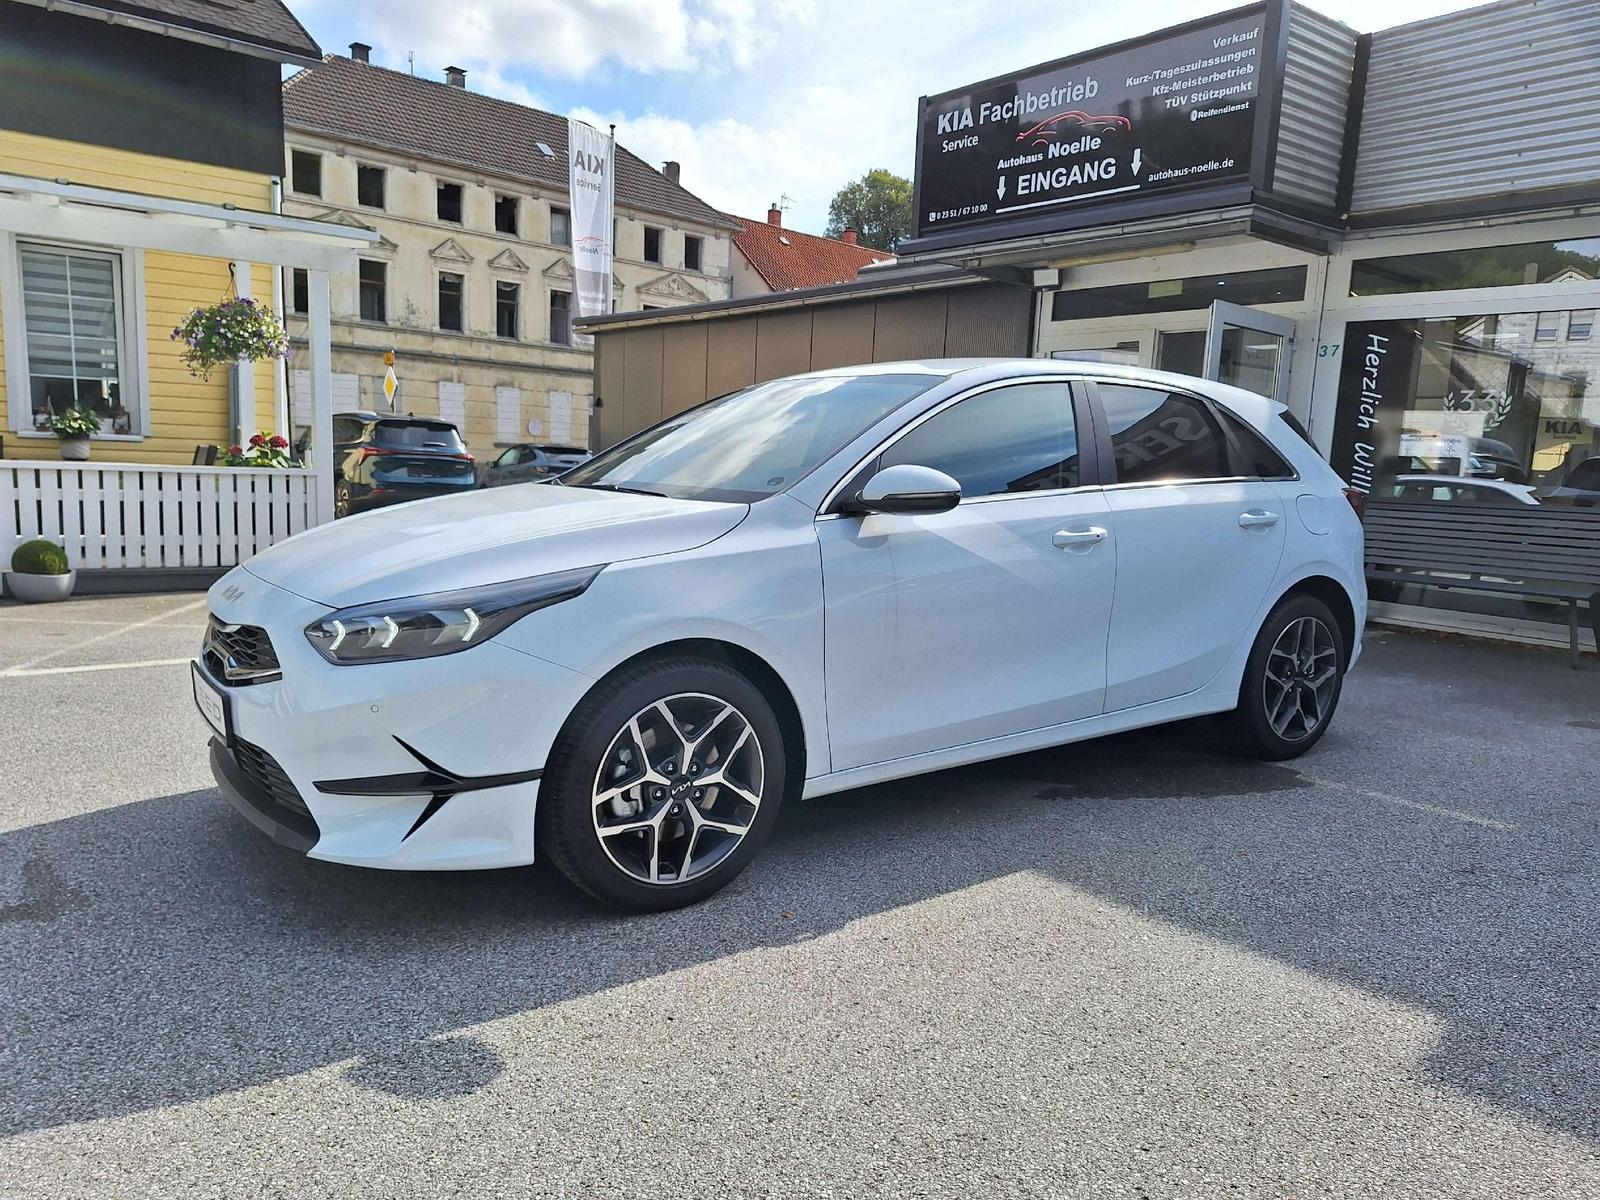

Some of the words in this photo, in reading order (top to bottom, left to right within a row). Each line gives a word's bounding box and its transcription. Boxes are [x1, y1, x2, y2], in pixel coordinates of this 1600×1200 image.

[1212, 27, 1260, 48] Verkauf
[1125, 47, 1256, 87] Kurz-/Tageszulassungen
[1152, 63, 1254, 96] Kfz-Meisterbetrieb
[937, 107, 974, 135] KIA
[979, 76, 1099, 125] Fachbetrieb
[1165, 95, 1189, 109] TÜV
[1190, 80, 1253, 103] Stützpunkt
[942, 134, 979, 153] Service
[997, 152, 1043, 170] Autohaus
[1048, 135, 1101, 159] Noelle
[1017, 157, 1117, 196] EINGANG
[1148, 158, 1234, 182] autohaus-noelle.de
[941, 210, 949, 219] 23
[950, 209, 957, 218] 51
[962, 206, 971, 215] 67
[971, 205, 979, 214] 10
[980, 203, 988, 212] 00
[1318, 344, 1340, 357] 37
[1357, 333, 1389, 429] Herzlich
[1460, 389, 1498, 414] 33
[1545, 420, 1582, 435] KIA
